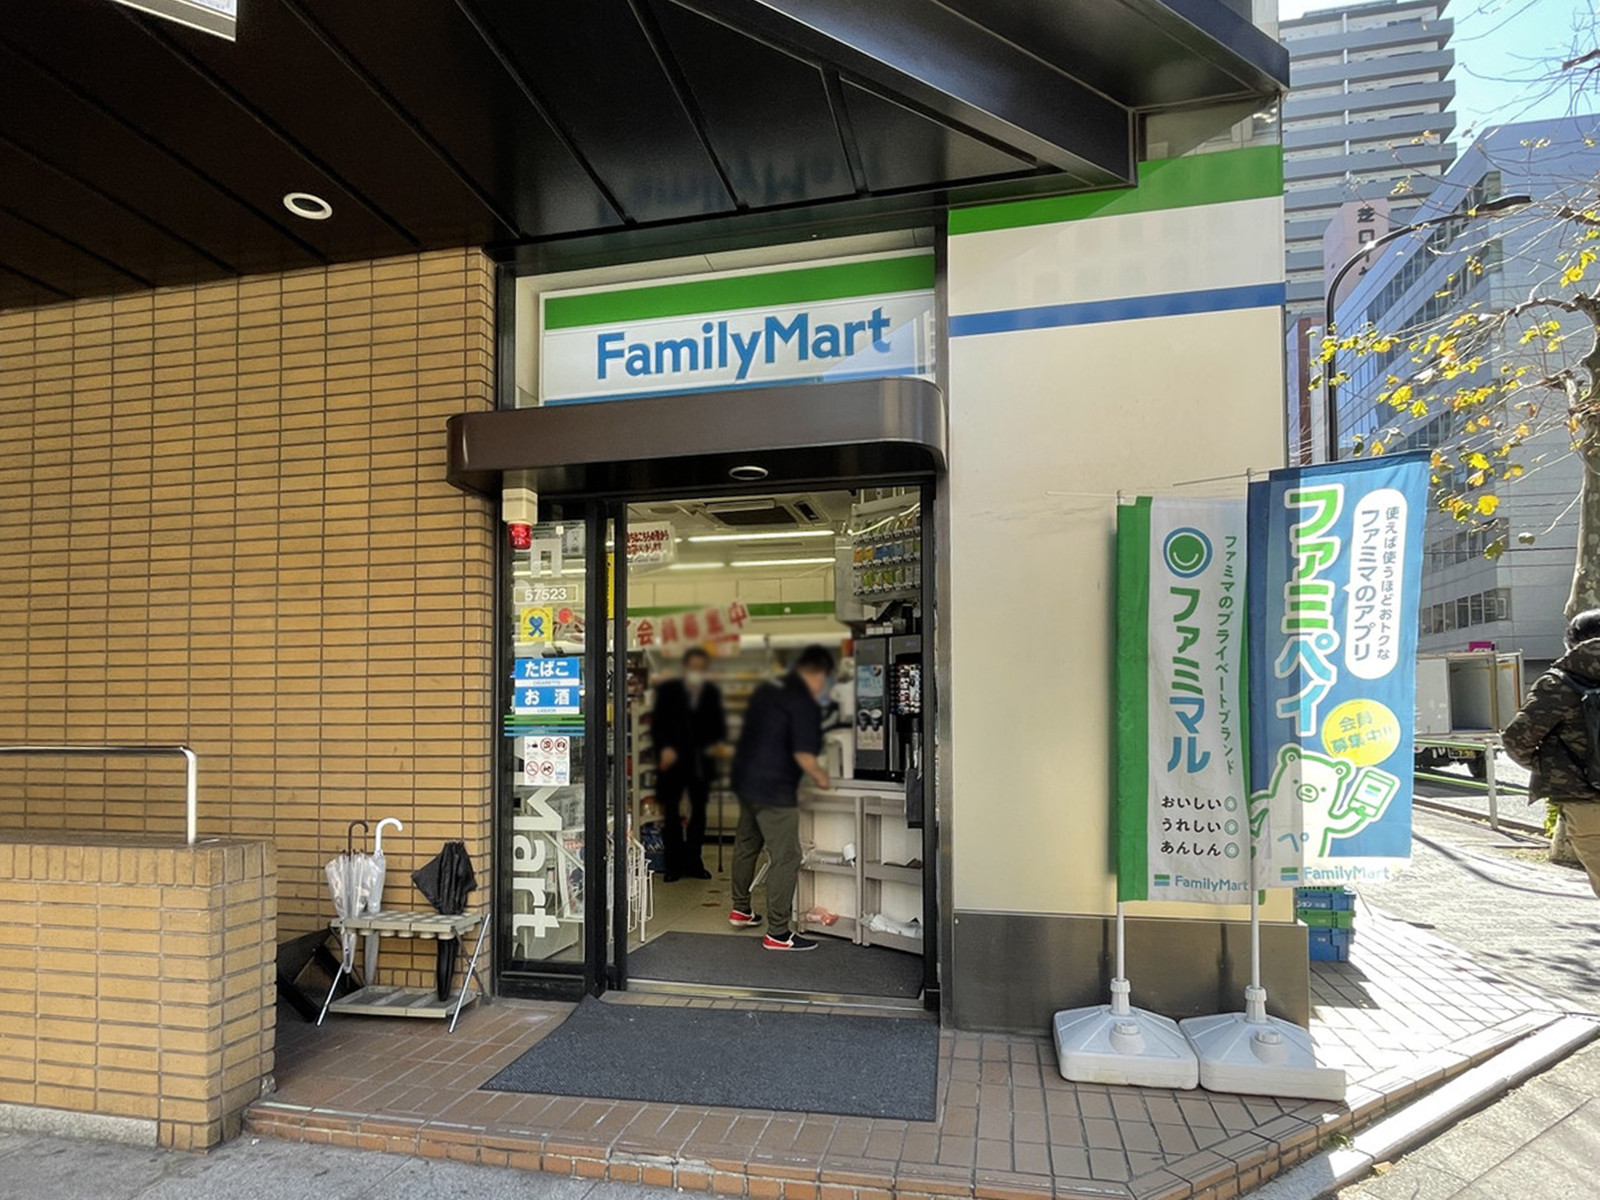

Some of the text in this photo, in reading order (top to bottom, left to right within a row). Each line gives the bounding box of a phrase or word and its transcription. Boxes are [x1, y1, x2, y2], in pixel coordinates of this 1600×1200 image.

[597, 306, 891, 381] FamilyMart
[1354, 509, 1381, 662] ファミマのアプリ
[1377, 506, 1400, 661] 使えば使うほどおトクな
[524, 588, 567, 601] 57523
[1277, 488, 1339, 733] ファミペイ
[636, 602, 748, 646] 会員中
[1215, 535, 1238, 776] ファミマのプライベートブランド
[524, 660, 570, 678] たばこ
[1167, 586, 1211, 774] ファミマル
[524, 688, 571, 706] お酒
[1338, 711, 1373, 733] 会員
[1161, 795, 1222, 810] おいしい
[1162, 817, 1222, 833] うれしい
[1160, 840, 1222, 857] あんしん
[1175, 874, 1249, 892] FamilyMart
[1303, 865, 1390, 881] FamilyMart
